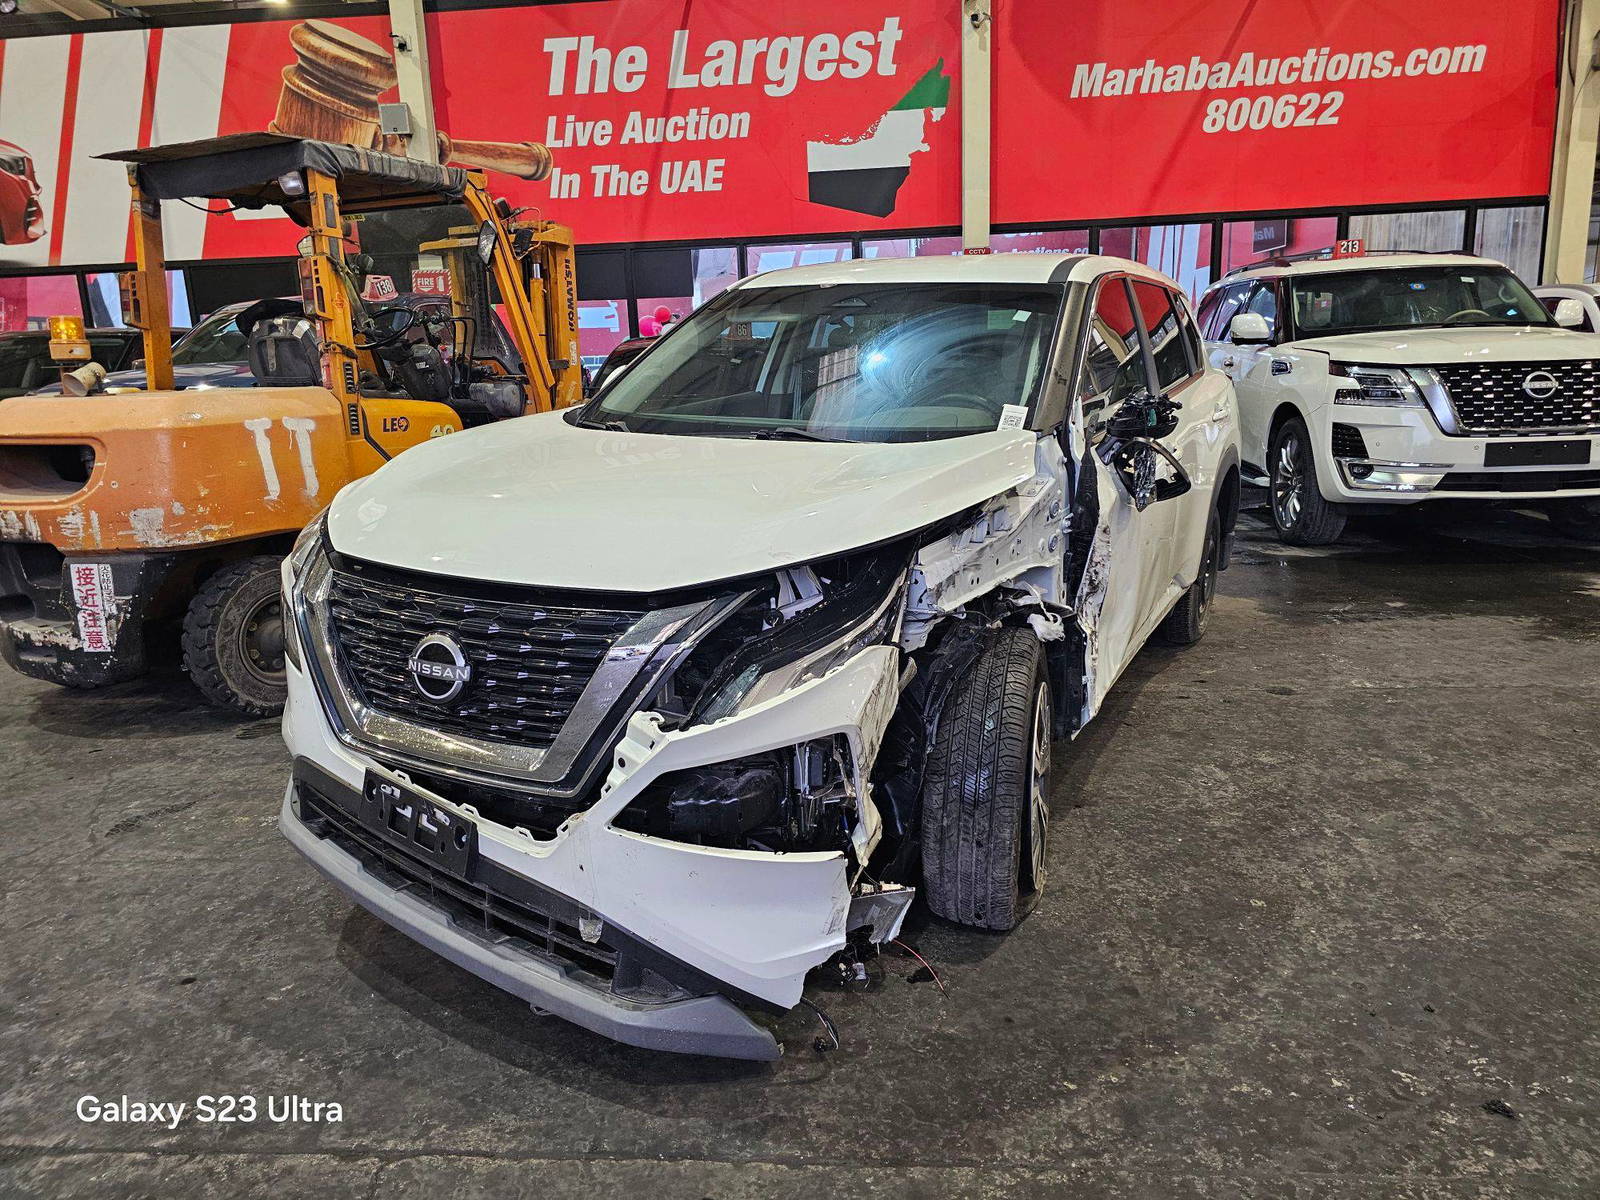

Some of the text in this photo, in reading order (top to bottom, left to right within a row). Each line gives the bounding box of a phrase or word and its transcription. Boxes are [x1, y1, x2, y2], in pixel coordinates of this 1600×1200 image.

[543, 17, 903, 97] The Largest
[1070, 43, 1488, 99] MarhabaAuctions.com
[546, 107, 750, 148] Live Auction
[1202, 91, 1345, 134] 800622
[550, 159, 726, 199] In The UAE
[1341, 240, 1360, 253] 213
[377, 279, 392, 296] 138
[417, 277, 434, 286] FIRE
[76, 567, 104, 649] 接近注意
[408, 659, 468, 680] NISSAN
